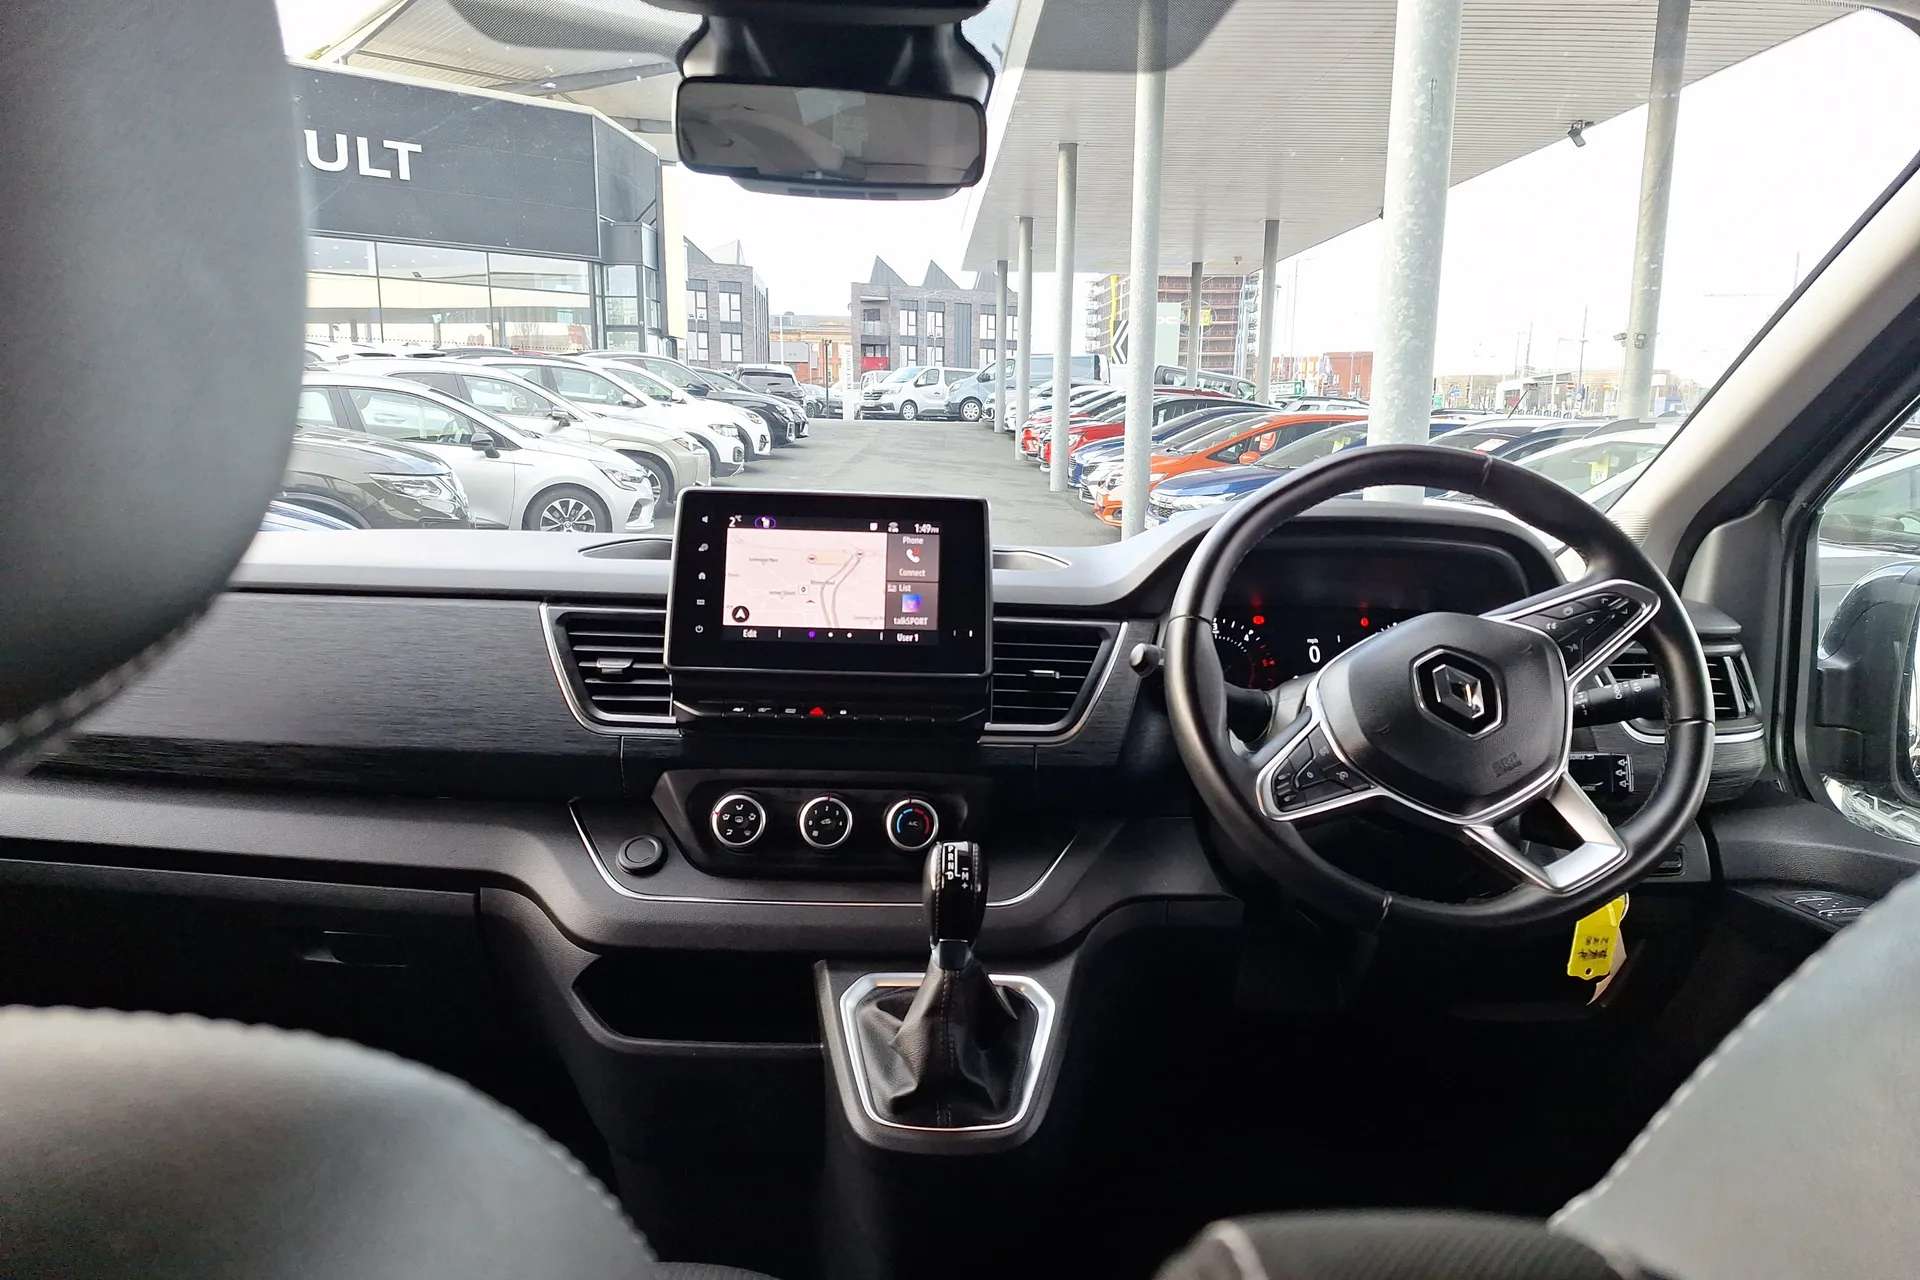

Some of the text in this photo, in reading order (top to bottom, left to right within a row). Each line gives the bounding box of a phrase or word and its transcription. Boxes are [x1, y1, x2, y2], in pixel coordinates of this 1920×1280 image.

[304, 128, 423, 181] ULT
[902, 535, 924, 545] Phone
[899, 568, 926, 577] Connect
[898, 584, 912, 593] List
[893, 616, 929, 626] talkSPORT
[742, 629, 758, 639] Edit
[896, 632, 913, 642] User
[1308, 645, 1321, 664] 0
